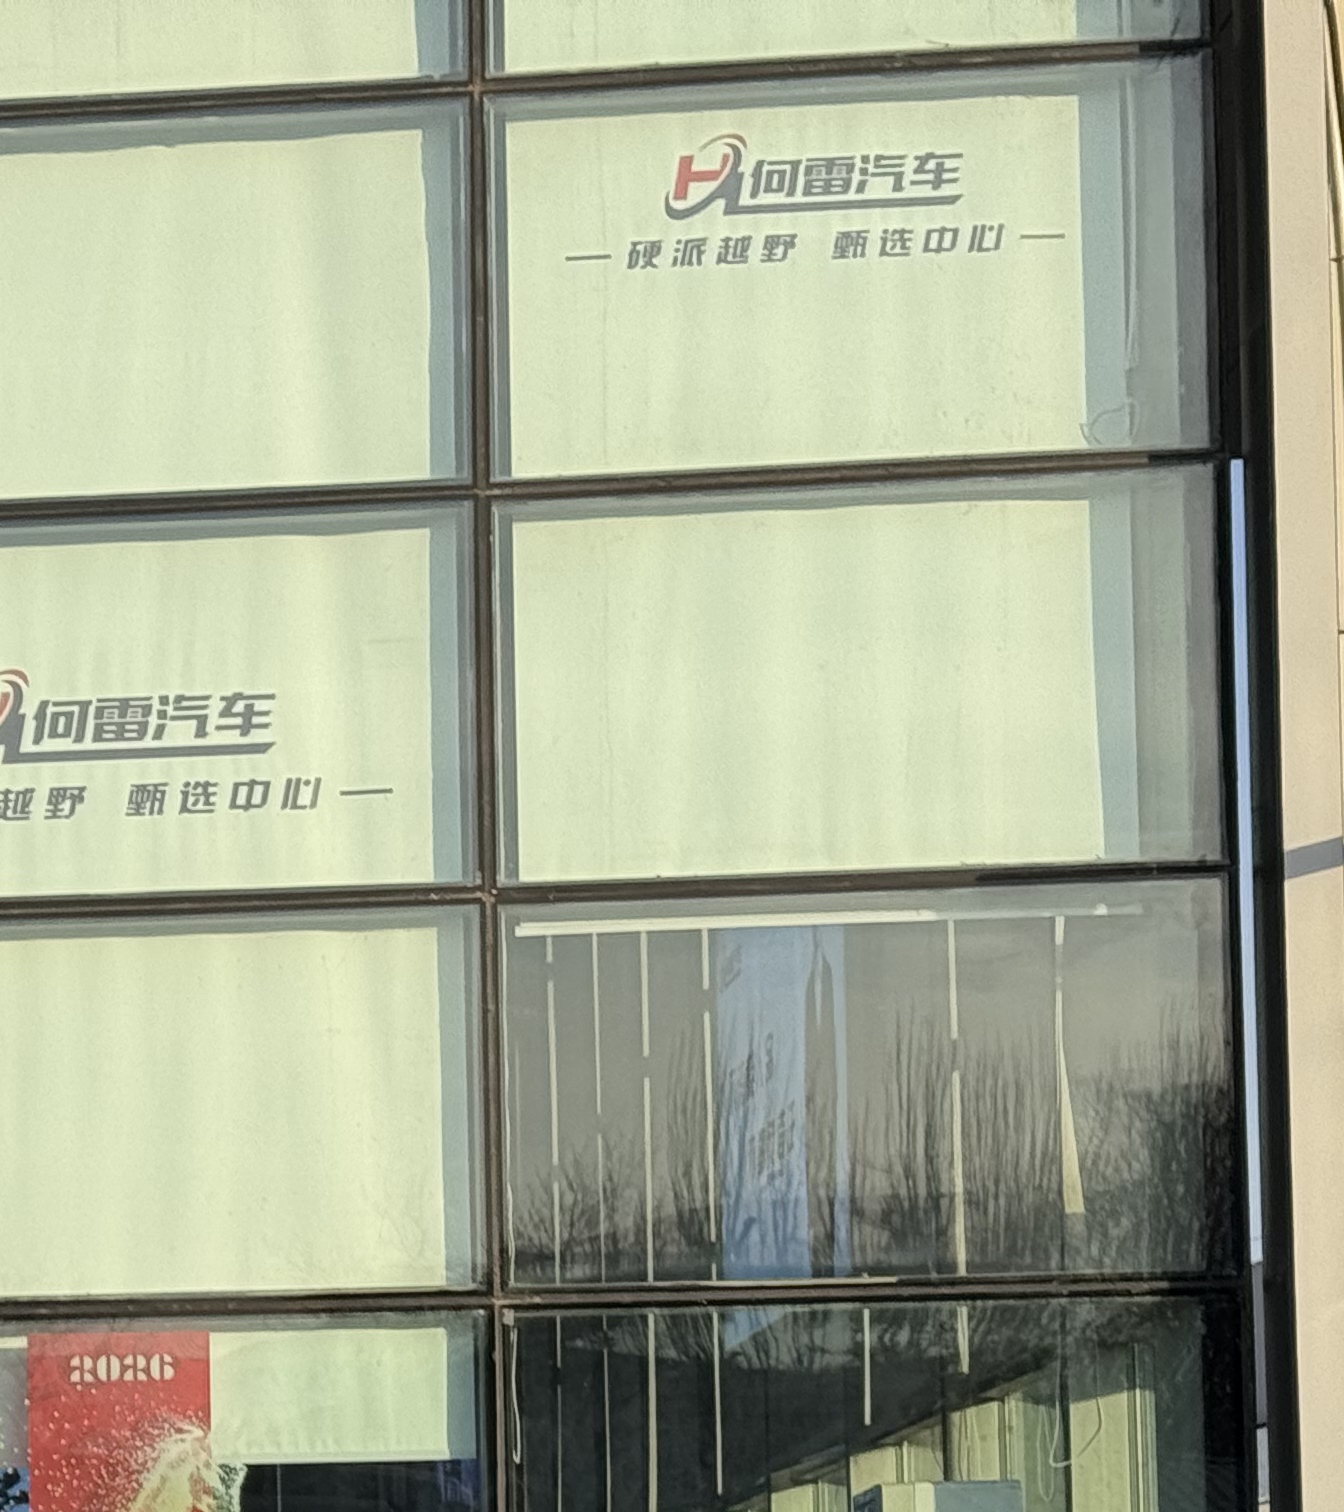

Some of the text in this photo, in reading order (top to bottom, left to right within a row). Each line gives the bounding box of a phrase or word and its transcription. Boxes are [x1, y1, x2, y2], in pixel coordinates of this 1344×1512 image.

[749, 152, 963, 200] 何雷汽车
[627, 223, 1004, 270] 硬派越野 甄选中心
[32, 692, 276, 745] 何雷汽车
[125, 777, 321, 817] 甄选中心
[69, 1353, 175, 1382] 2026
